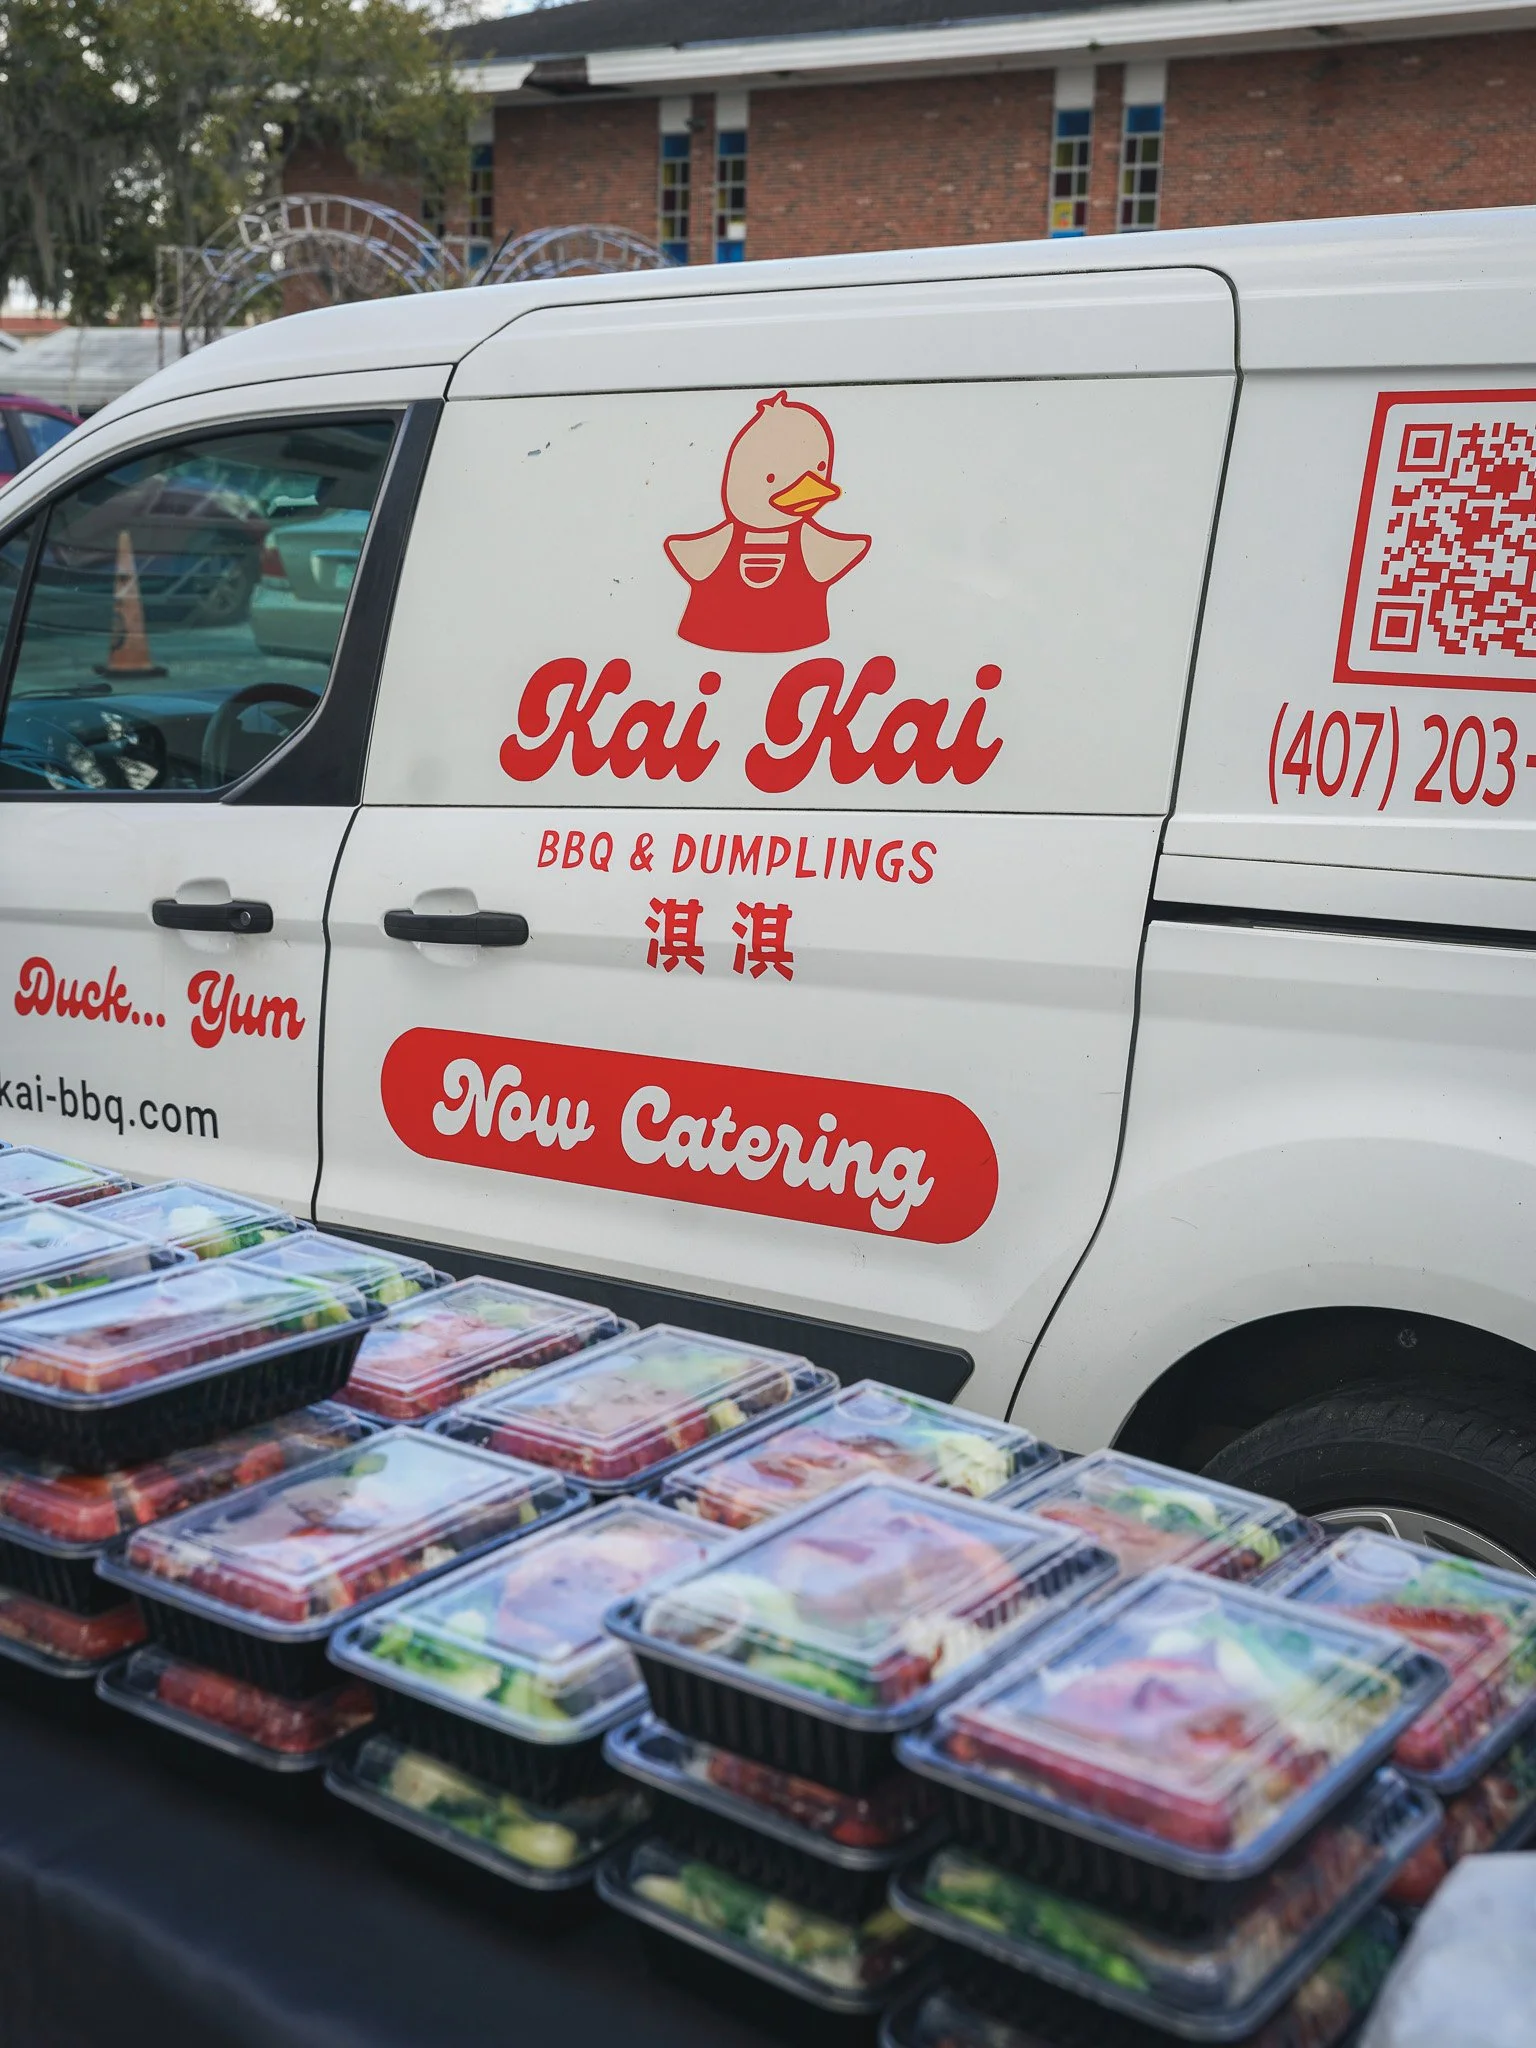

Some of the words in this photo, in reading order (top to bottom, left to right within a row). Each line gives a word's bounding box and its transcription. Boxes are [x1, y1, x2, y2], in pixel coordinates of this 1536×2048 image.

[500, 657, 721, 783] Kai
[745, 655, 1003, 793] Kai
[1269, 702, 1399, 810] (407)
[538, 830, 613, 872] BBQ
[630, 833, 653, 872] &
[672, 834, 937, 884] DUMPLINGS
[15, 956, 165, 1027] Duck...
[188, 970, 305, 1048] Yum
[0, 1070, 219, 1139] kai-bbq.com
[432, 1058, 595, 1150] Now
[621, 1086, 935, 1231] Catering
